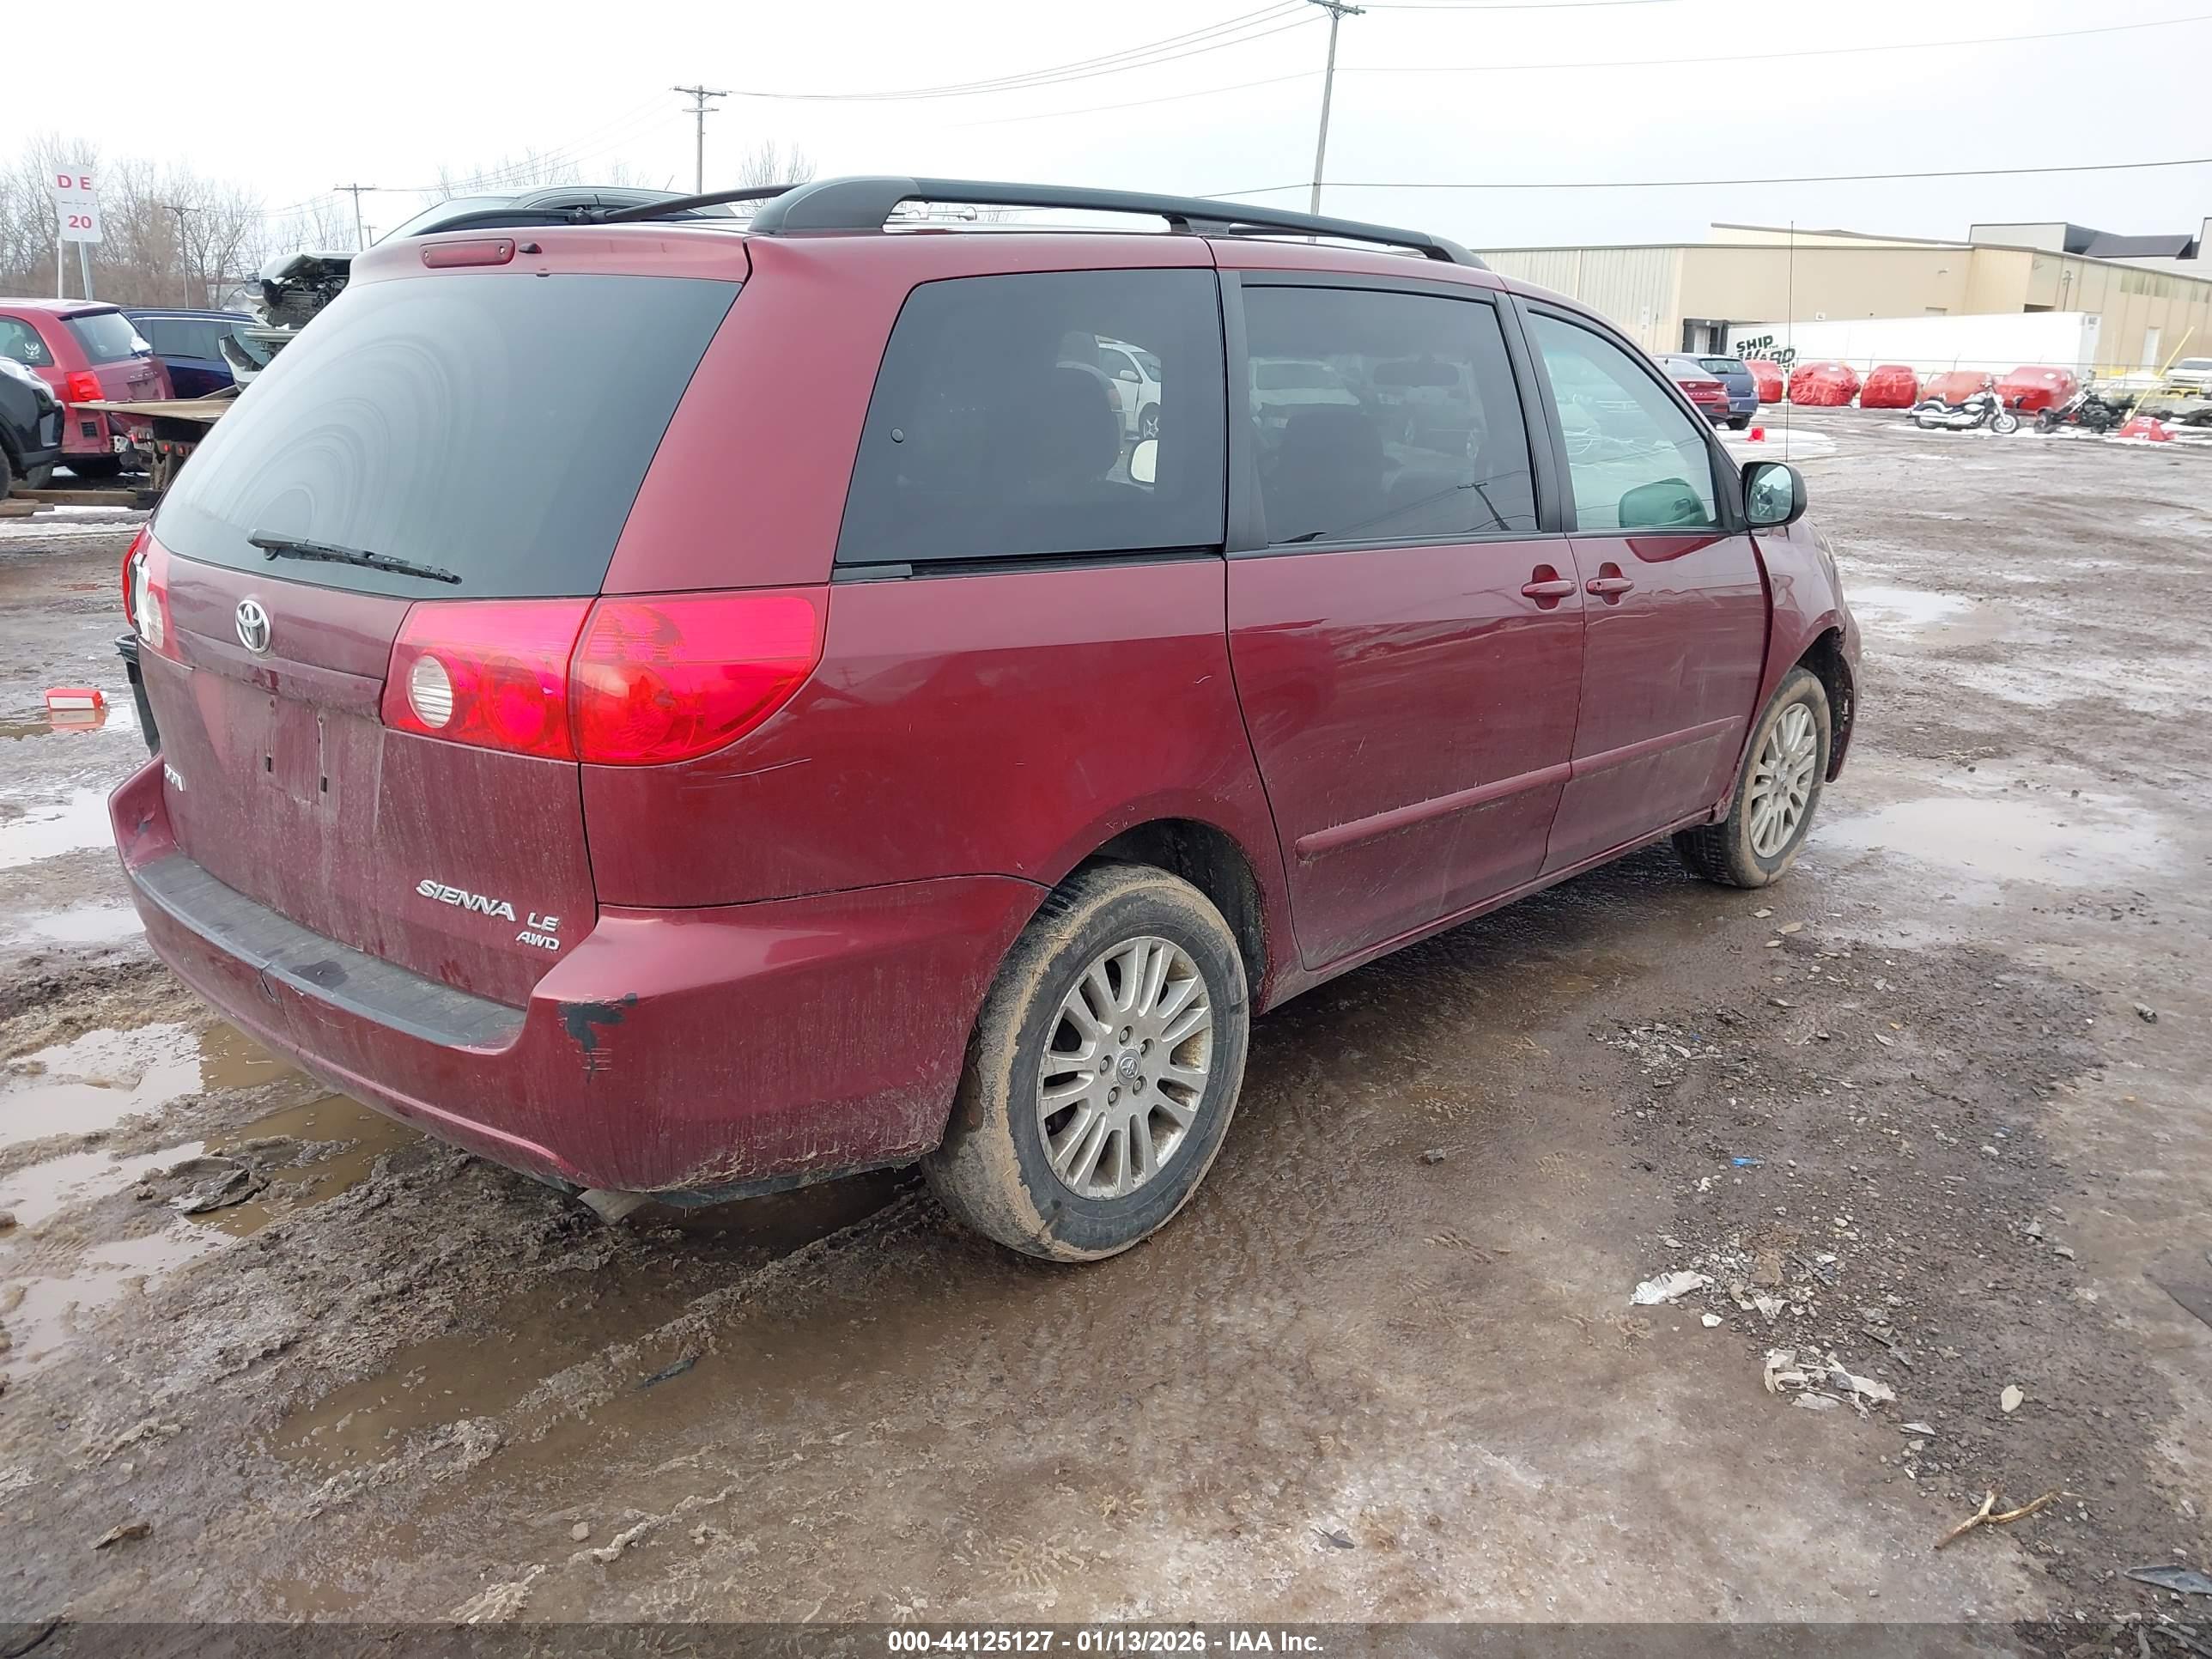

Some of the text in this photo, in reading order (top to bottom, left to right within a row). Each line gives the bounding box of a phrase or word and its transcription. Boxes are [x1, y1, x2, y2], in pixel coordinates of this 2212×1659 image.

[68, 215, 93, 229] 20
[1736, 335, 1773, 353] SHIP
[416, 879, 560, 933] SIENNA LE
[515, 931, 560, 951] AWD
